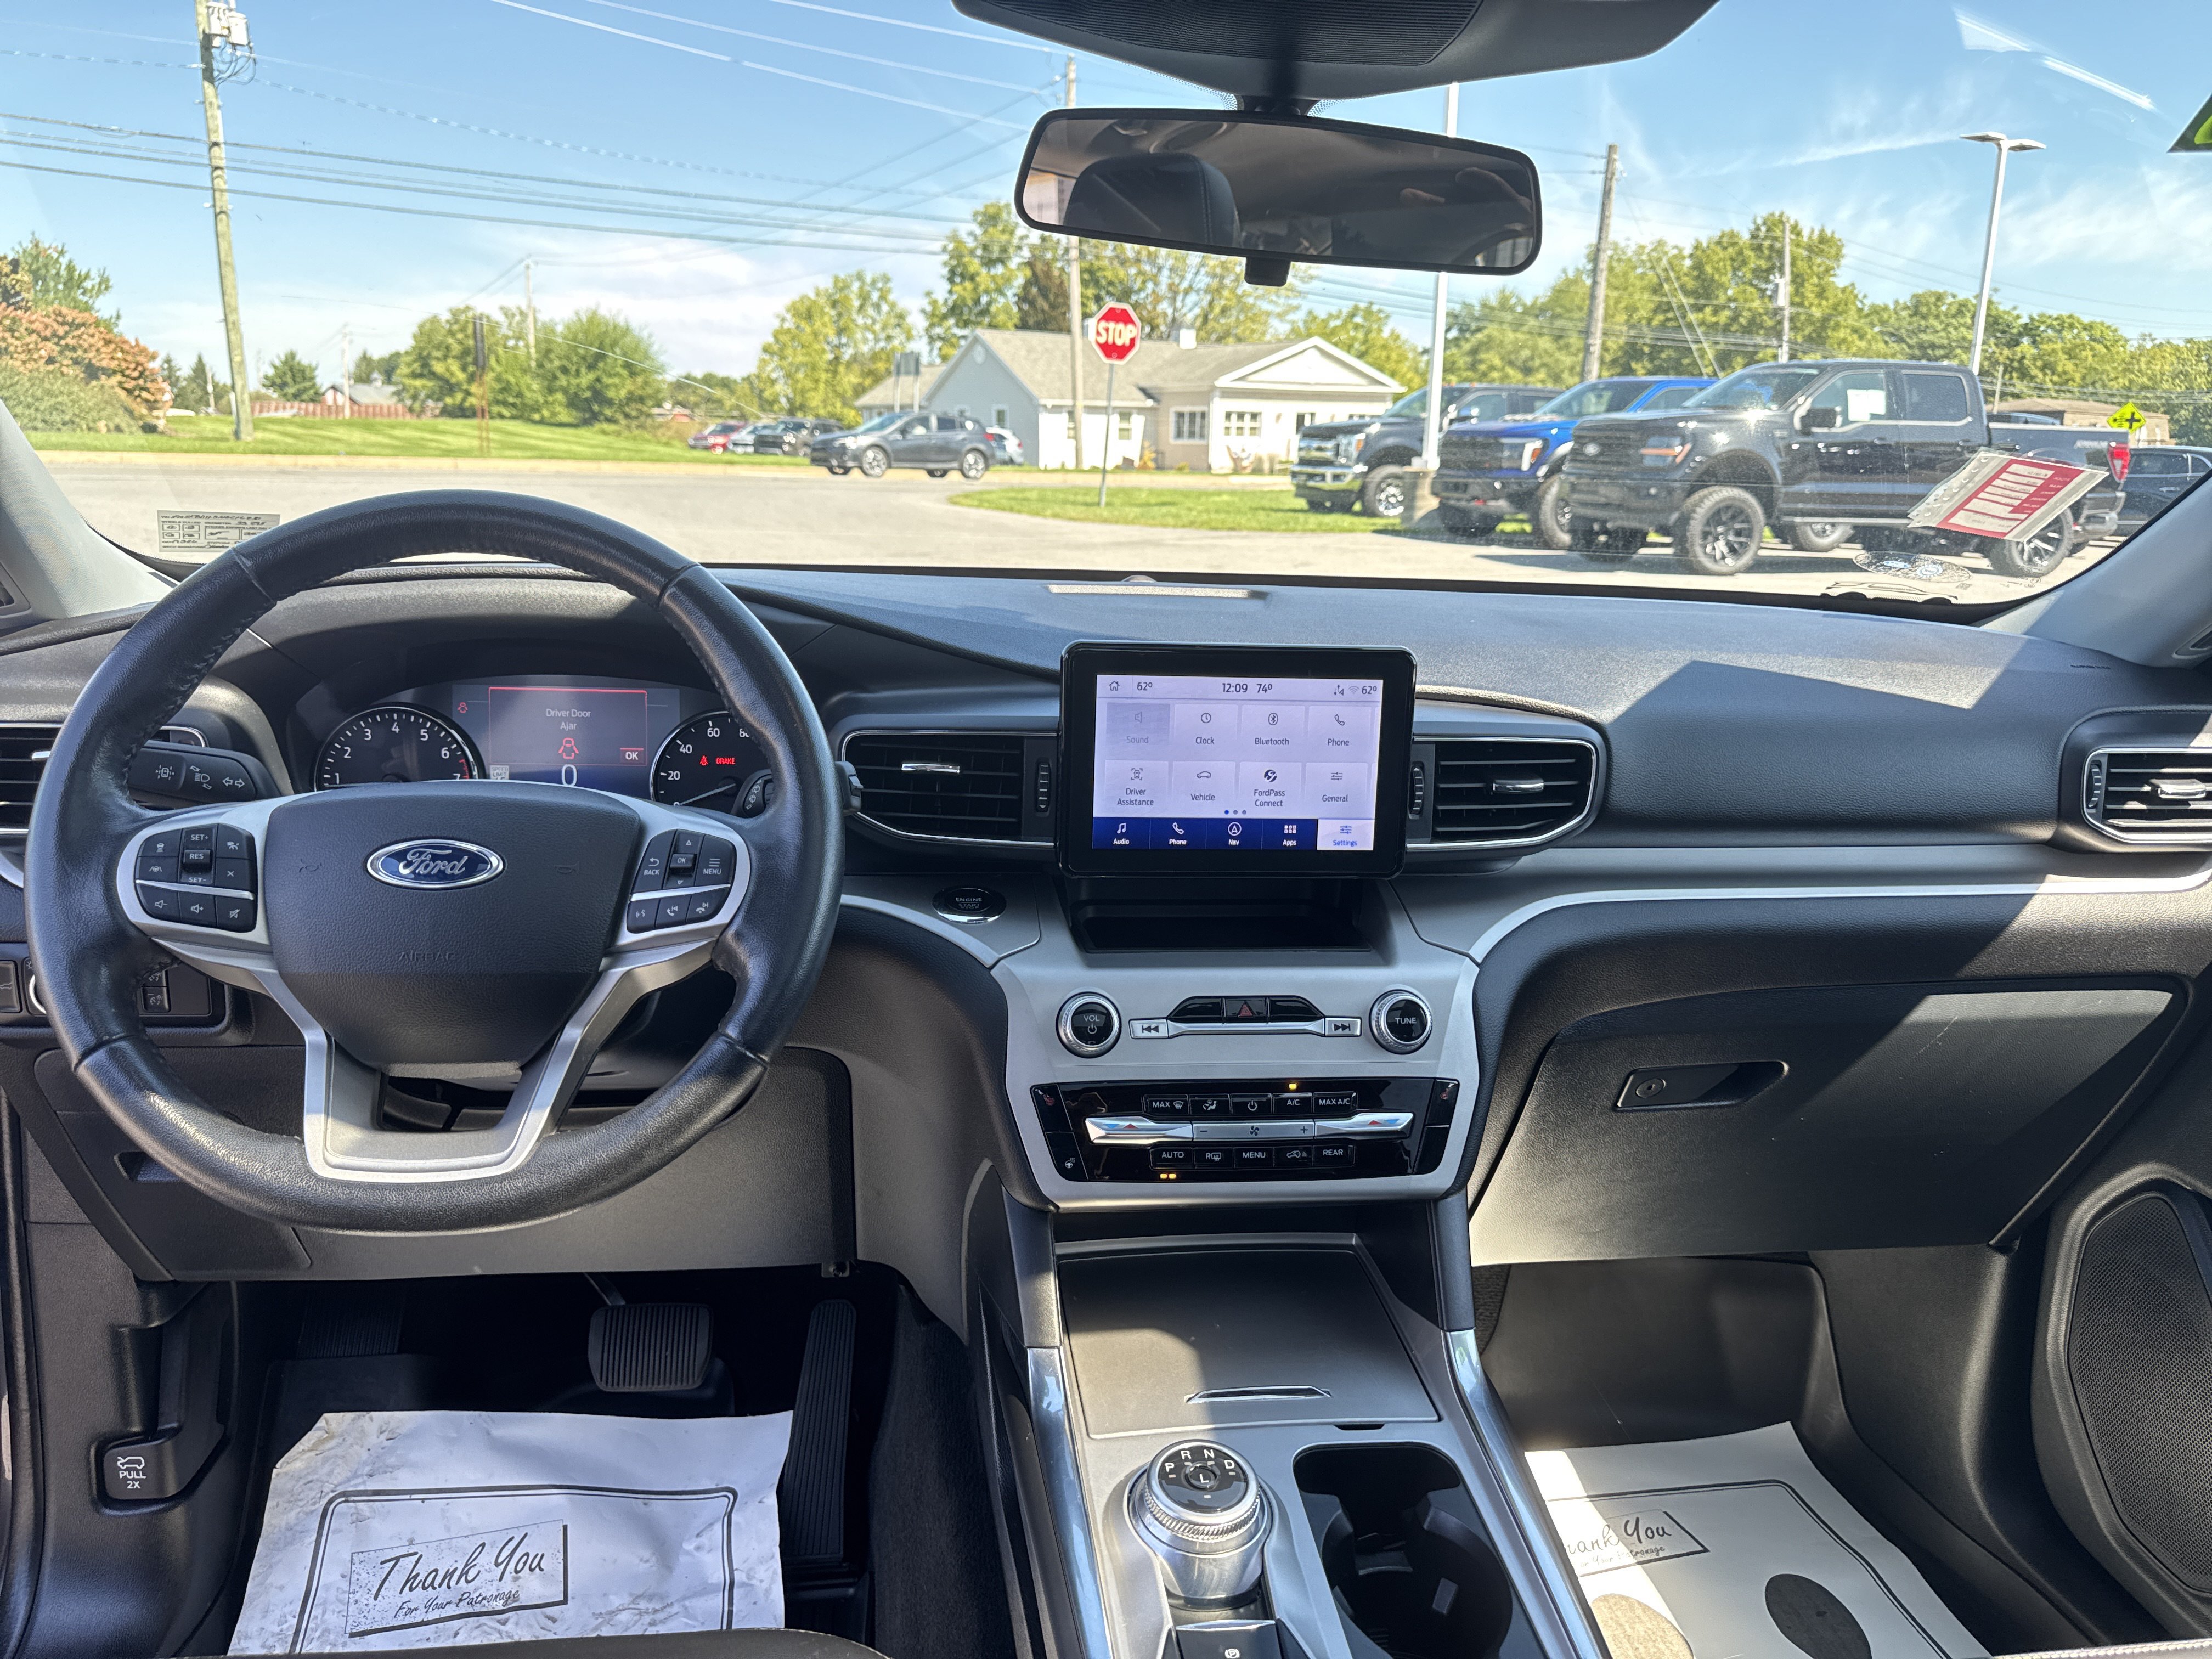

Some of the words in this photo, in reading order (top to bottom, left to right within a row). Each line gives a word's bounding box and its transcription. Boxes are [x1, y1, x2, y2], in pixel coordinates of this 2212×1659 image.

[1096, 320, 1137, 347] STOP
[1222, 683, 1248, 693] 12:09
[546, 709, 570, 717] Driver
[572, 709, 591, 718] Door
[391, 722, 400, 733] 4
[560, 721, 577, 731] Ajar
[364, 729, 372, 741] 3
[420, 729, 428, 741] 5
[707, 728, 720, 737] 60
[343, 747, 352, 759] 2
[441, 747, 450, 759] 6
[679, 744, 692, 754] 40
[625, 752, 639, 760] OK
[335, 772, 340, 784] 1
[561, 764, 577, 787] 0
[668, 771, 680, 780] 20
[398, 848, 468, 875] Ford
[1180, 1450, 1191, 1460] R
[1204, 1449, 1215, 1458] N
[1165, 1462, 1175, 1472] P
[1224, 1460, 1235, 1470] D
[119, 1470, 146, 1479] PULL
[1199, 1474, 1209, 1483] L
[1623, 1517, 1672, 1544] You
[374, 1542, 486, 1601] Thank
[494, 1532, 545, 1582] You
[394, 1600, 420, 1618] For
[425, 1596, 453, 1613] Your
[456, 1589, 521, 1607] Patronage
